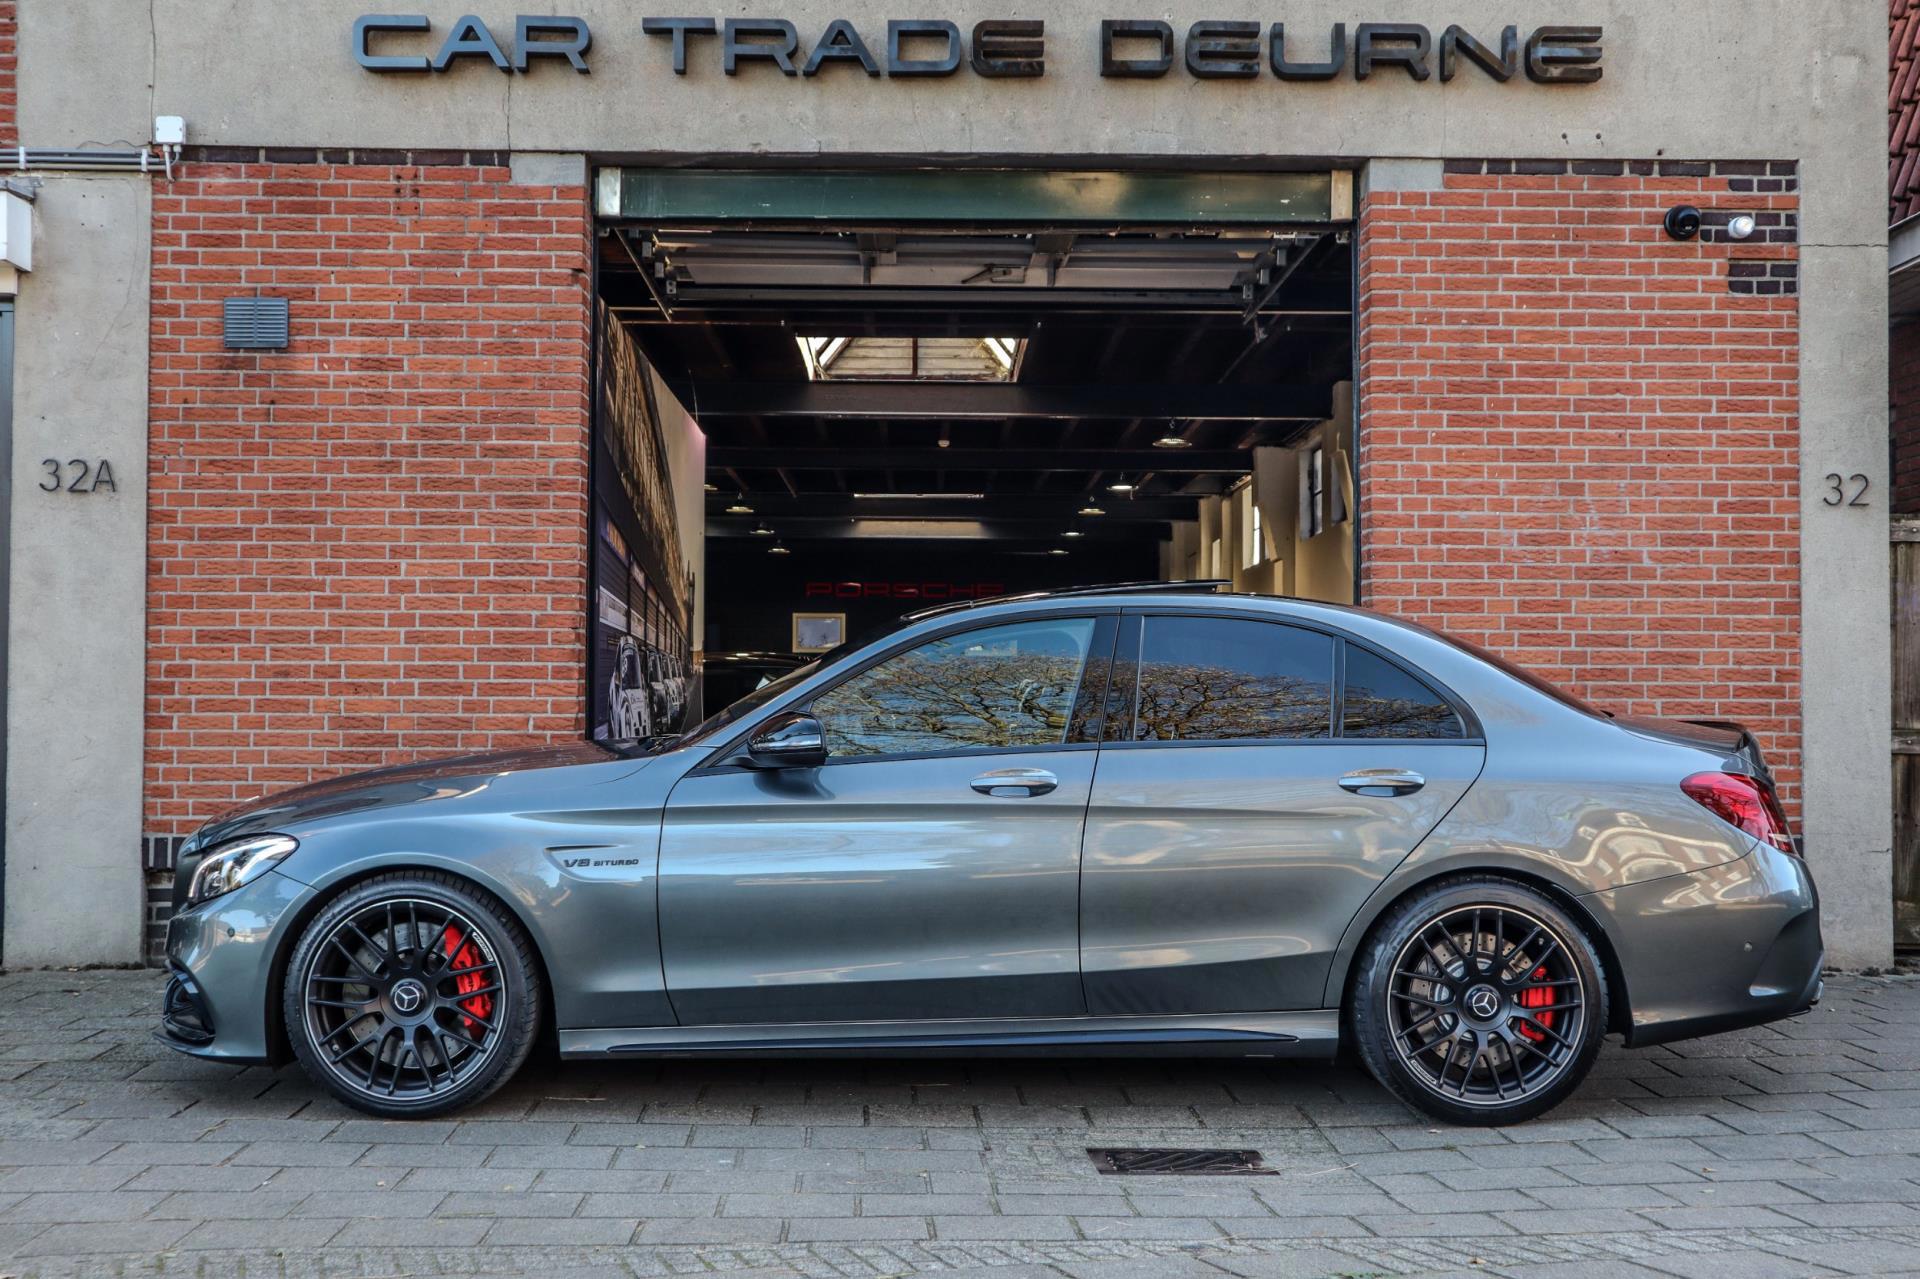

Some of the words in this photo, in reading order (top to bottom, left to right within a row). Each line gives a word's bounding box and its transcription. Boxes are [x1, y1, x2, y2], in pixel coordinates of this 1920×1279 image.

[351, 14, 594, 75] CAR
[642, 16, 1044, 79] TRADE
[1100, 19, 1604, 84] DEURNE
[39, 459, 116, 492] 32A
[1823, 472, 1870, 507] 32
[805, 581, 1004, 599] PORSCHE
[563, 858, 591, 868] V8
[592, 858, 640, 867] BITURBO
